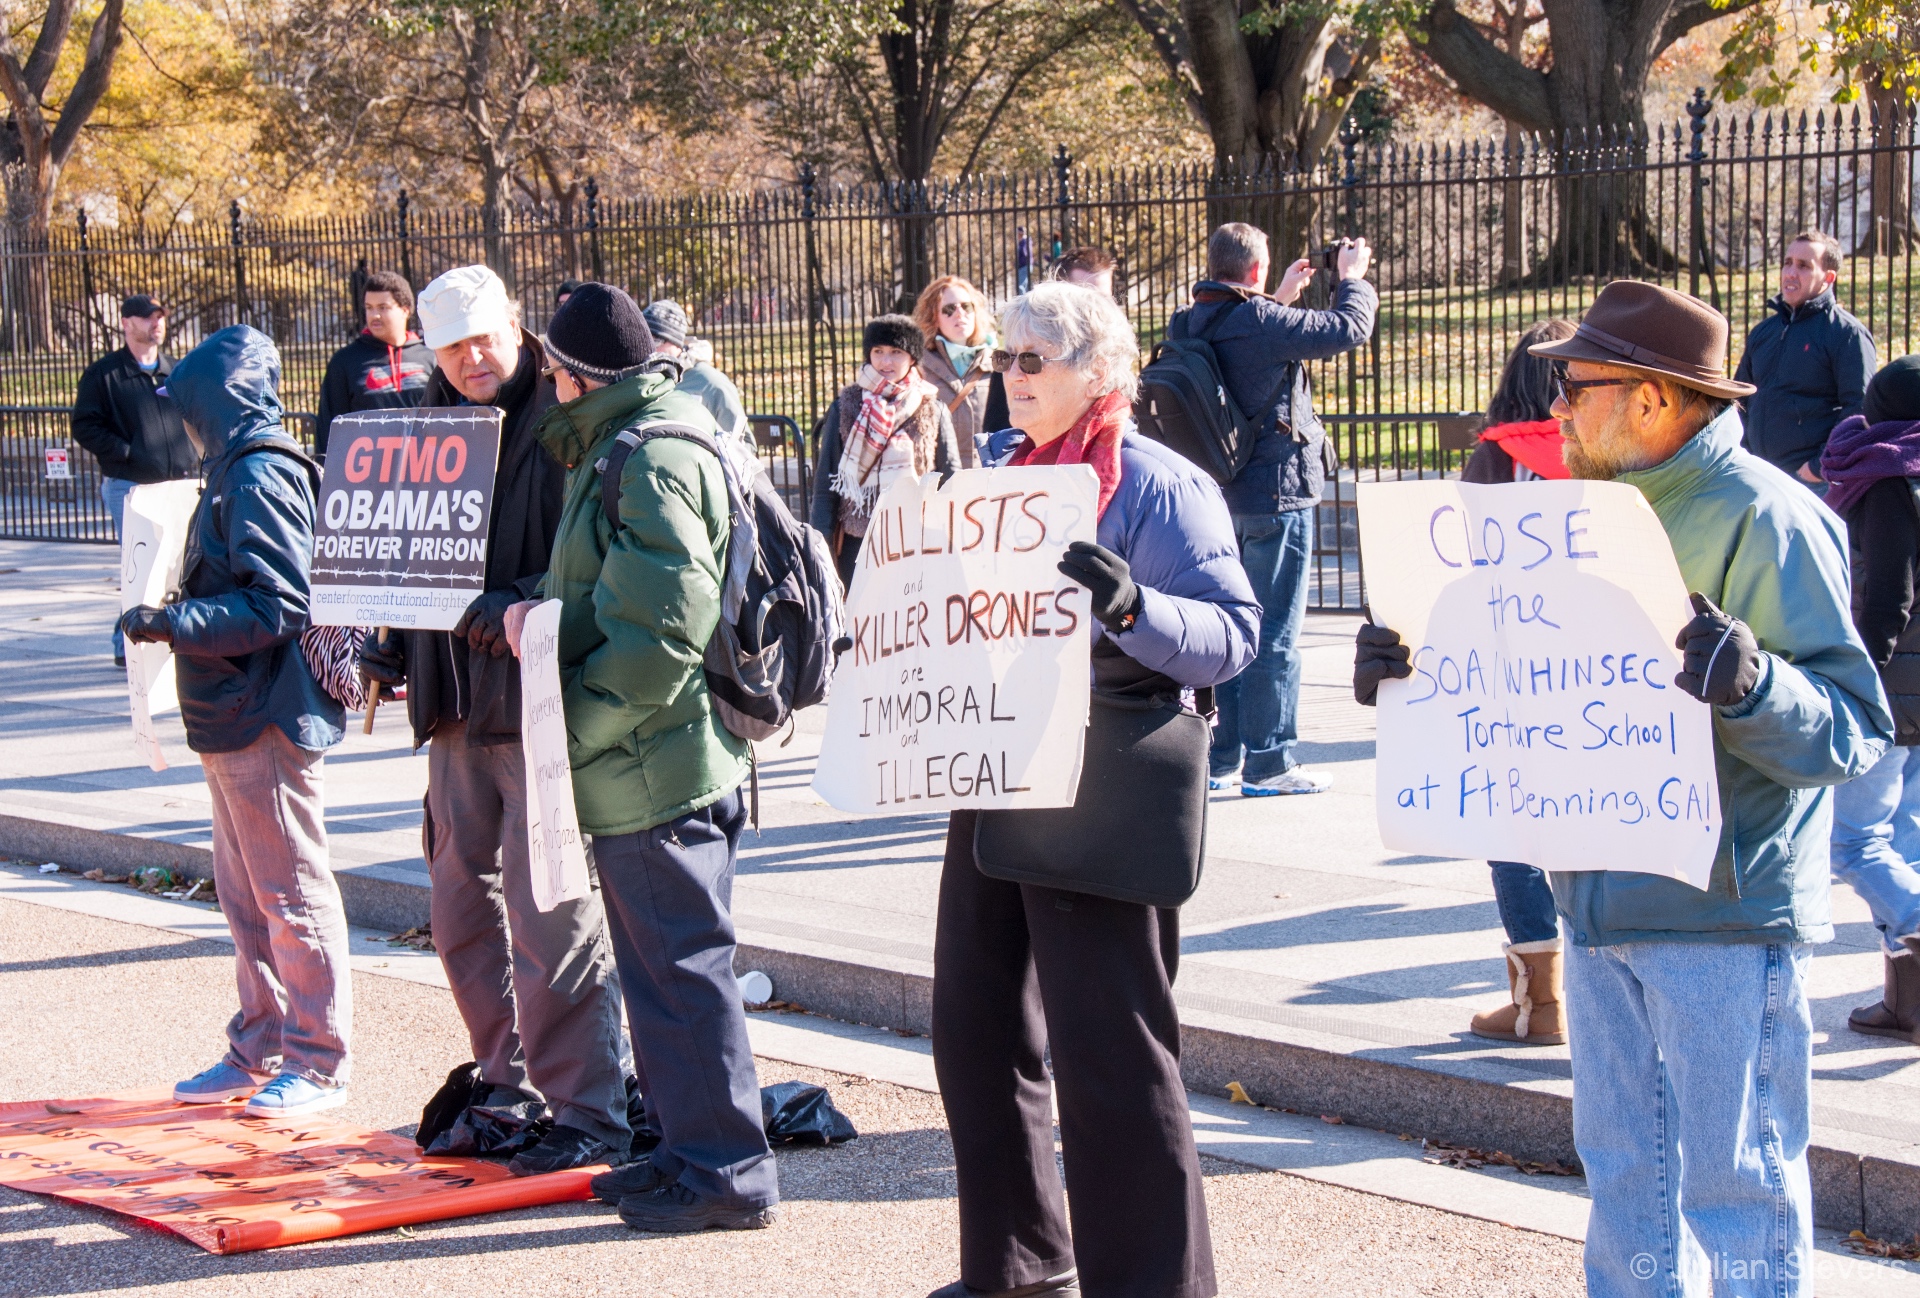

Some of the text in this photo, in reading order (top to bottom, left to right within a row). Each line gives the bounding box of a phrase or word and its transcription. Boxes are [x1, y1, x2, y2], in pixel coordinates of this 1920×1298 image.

[344, 435, 468, 484] GTMO
[324, 489, 484, 532] OBAMA'S
[313, 535, 486, 562] FOREVER PRISON
[1429, 504, 1599, 571] CLOSE
[903, 571, 924, 596] and
[1487, 584, 1561, 631] the
[854, 600, 930, 667] KILLER
[945, 586, 1080, 646] DRONES
[901, 667, 924, 685] are
[1406, 645, 1666, 706] SOA/WHINSEC
[859, 682, 1016, 738] IMMORAL
[1457, 700, 1677, 755] Torture School
[901, 730, 920, 747] and
[875, 750, 1032, 807] ILLEGAL
[1397, 774, 1441, 811] at
[1507, 768, 1651, 824] Benning,
[1658, 777, 1713, 832] GA!
